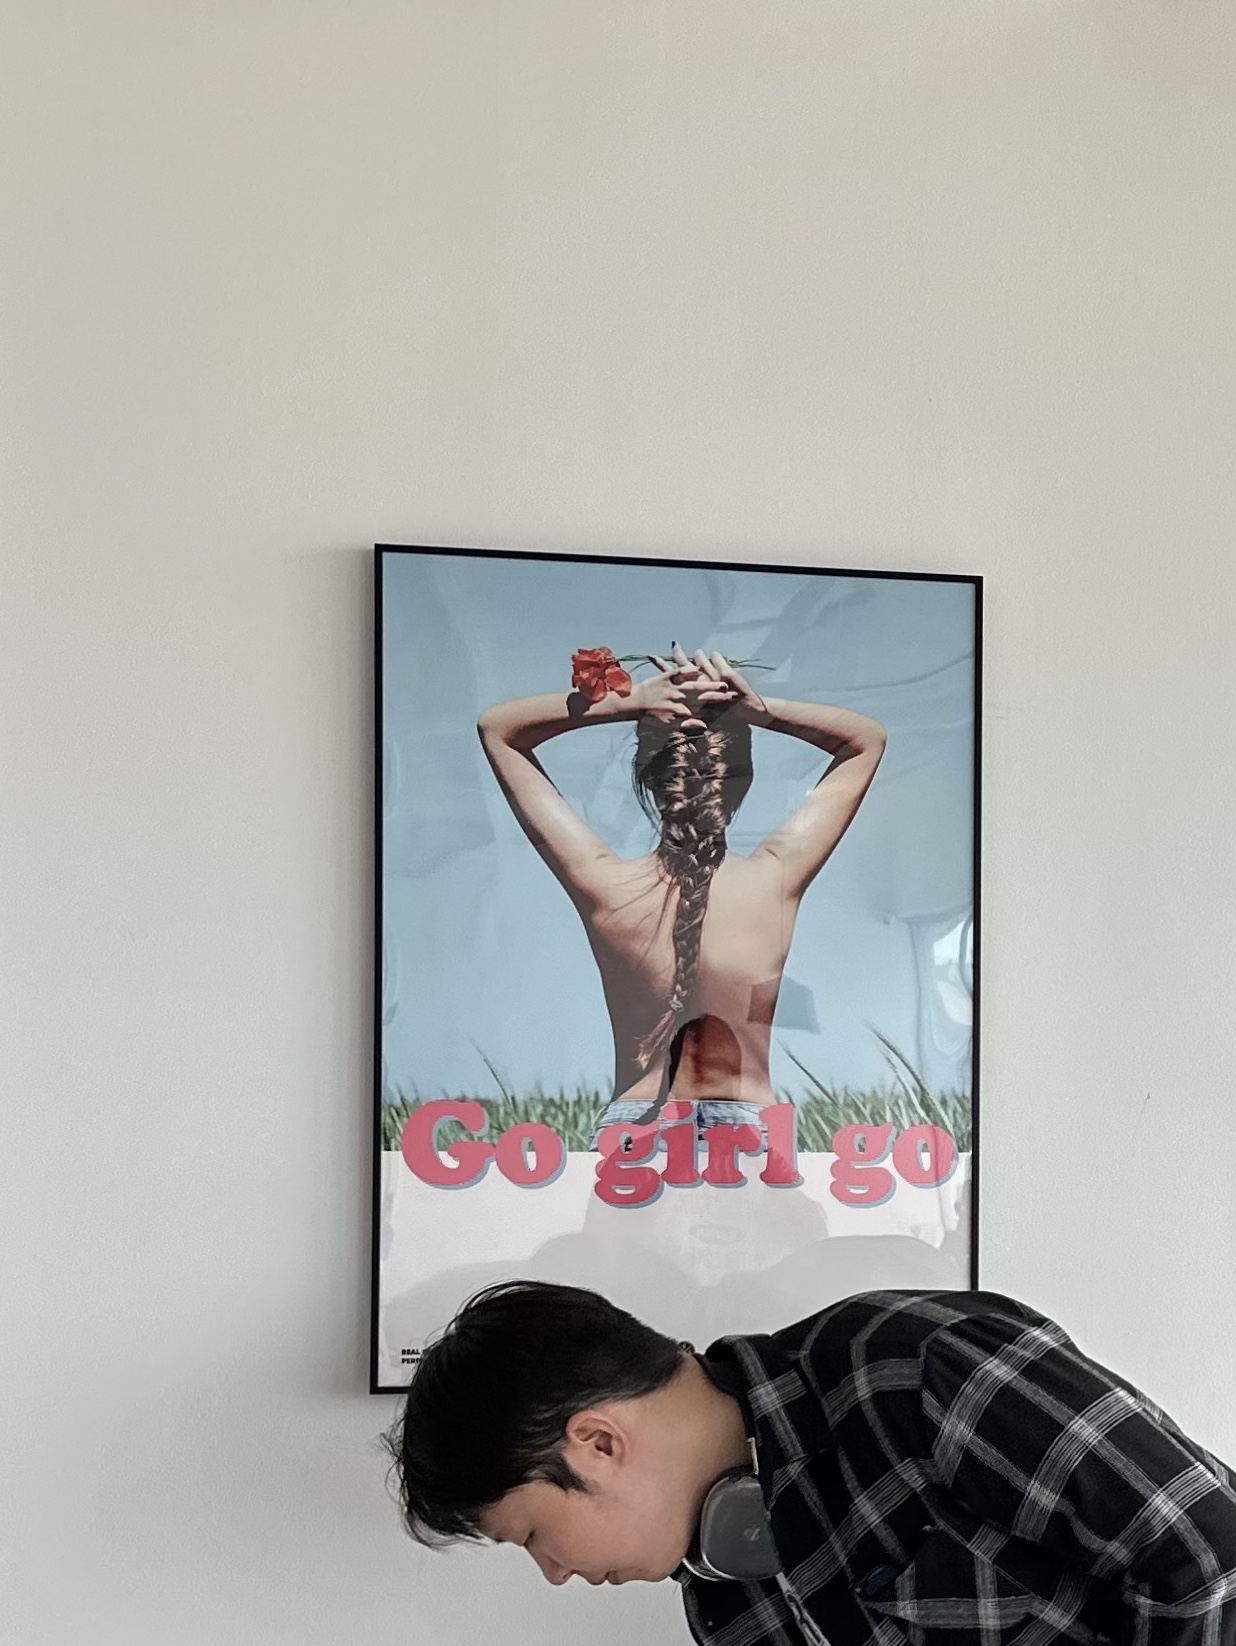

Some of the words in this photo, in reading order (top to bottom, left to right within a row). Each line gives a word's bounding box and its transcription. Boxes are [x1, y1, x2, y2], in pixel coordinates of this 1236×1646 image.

[401, 1099, 567, 1189] Go
[594, 1101, 804, 1208] girl
[829, 1121, 959, 1208] go
